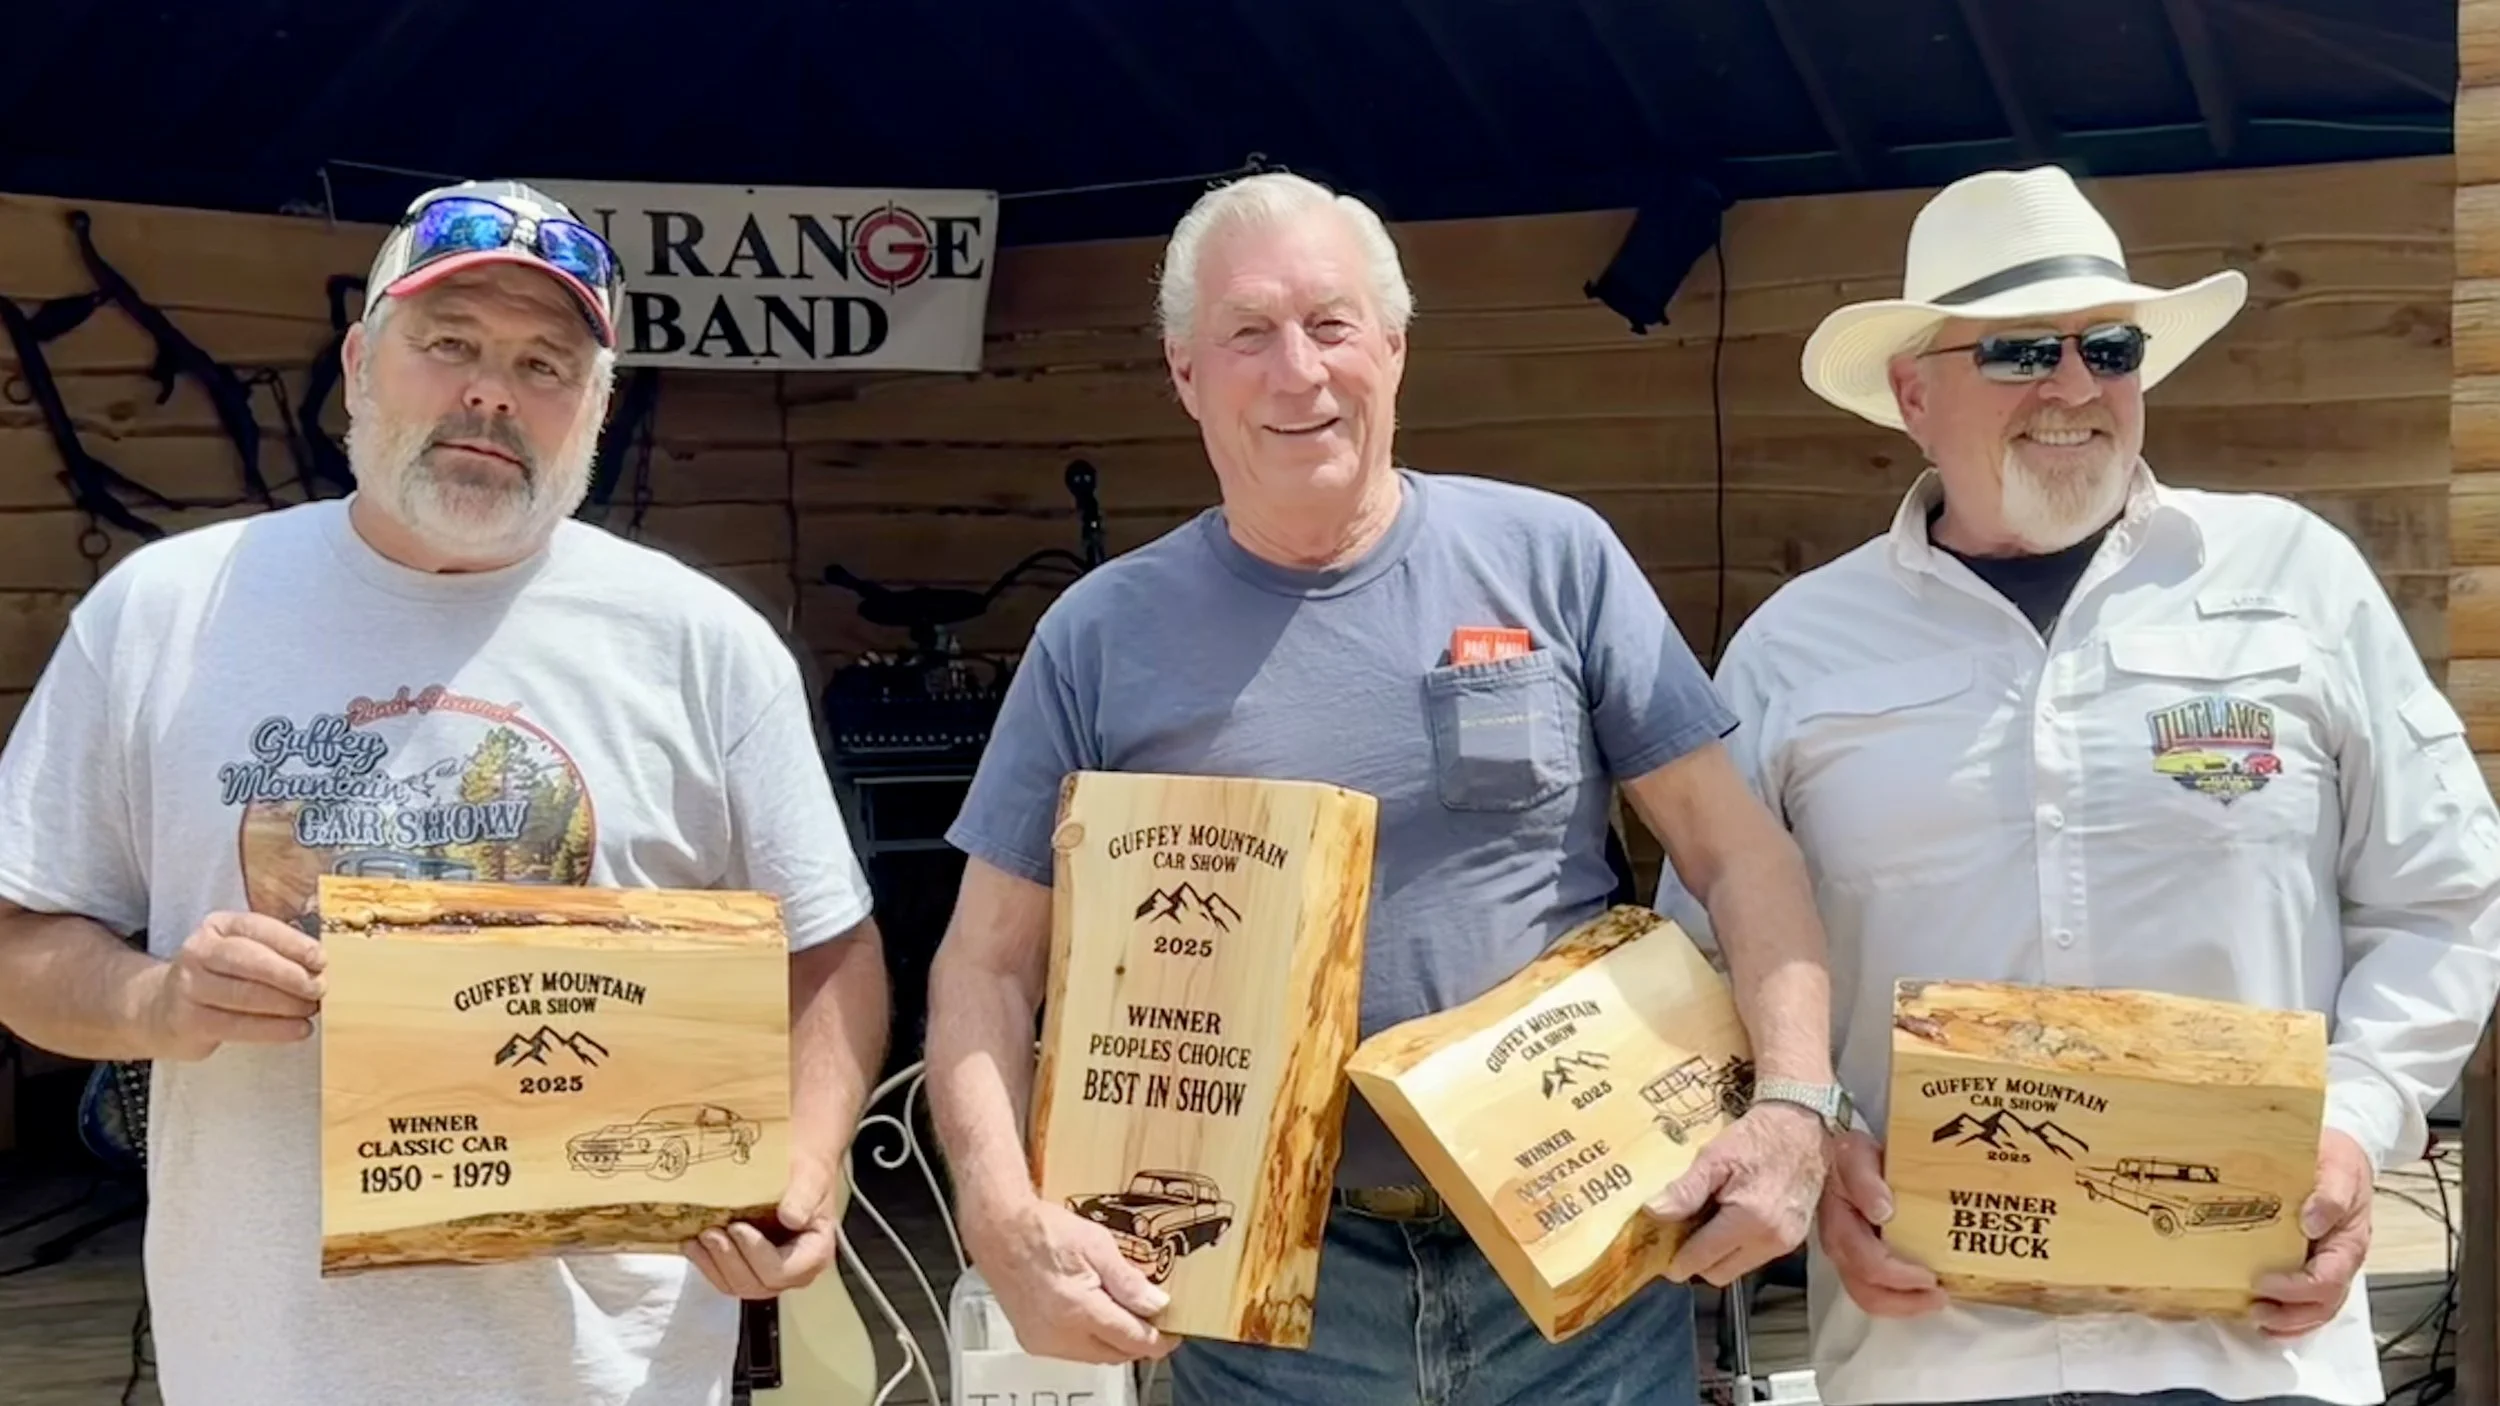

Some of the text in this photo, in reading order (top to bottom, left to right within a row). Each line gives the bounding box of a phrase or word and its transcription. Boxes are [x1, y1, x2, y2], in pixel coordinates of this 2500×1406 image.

[643, 204, 984, 291] RANGE
[626, 291, 889, 359] BAND
[252, 715, 387, 770] Guffey
[2152, 697, 2272, 754] OUTLAWS
[220, 761, 405, 803] Mountain
[297, 799, 527, 844] CAR SHOW
[1108, 824, 1289, 870] GUFFEY MOUNTAIN
[1153, 851, 1240, 873] CAR SHOW
[1153, 936, 1213, 958] 2025
[454, 971, 647, 1012] GUFFEY MOUNTAIN
[506, 997, 598, 1016] CAR SHOW
[1128, 1004, 1222, 1035] WINNER
[1485, 1000, 1602, 1074] GUFFEY MOUNTAIN
[1089, 1033, 1252, 1070] PEOPLES CHOICE
[1520, 1023, 1578, 1062] CAR SHOW
[520, 1075, 583, 1094] 2025
[1083, 1068, 1247, 1117] BEST IN SHOW
[1571, 1080, 1613, 1110] 2025
[1921, 1077, 2108, 1113] GUFFEY MOUNTAIN
[1970, 1094, 2059, 1113] CAR SHOW
[388, 1115, 479, 1134] WINNER
[358, 1136, 508, 1158] CLASSIC CAR
[1514, 1128, 1576, 1170] WINNER
[1987, 1150, 2031, 1163] 2025
[361, 1165, 422, 1193] 1950
[453, 1161, 512, 1188] 1979
[1515, 1139, 1611, 1204] VINTAGE
[1534, 1163, 1633, 1233] PRE 1949
[1950, 1190, 2057, 1215] WINNER
[1952, 1209, 2050, 1234] BEST
[1948, 1230, 2049, 1259] TRUCK
